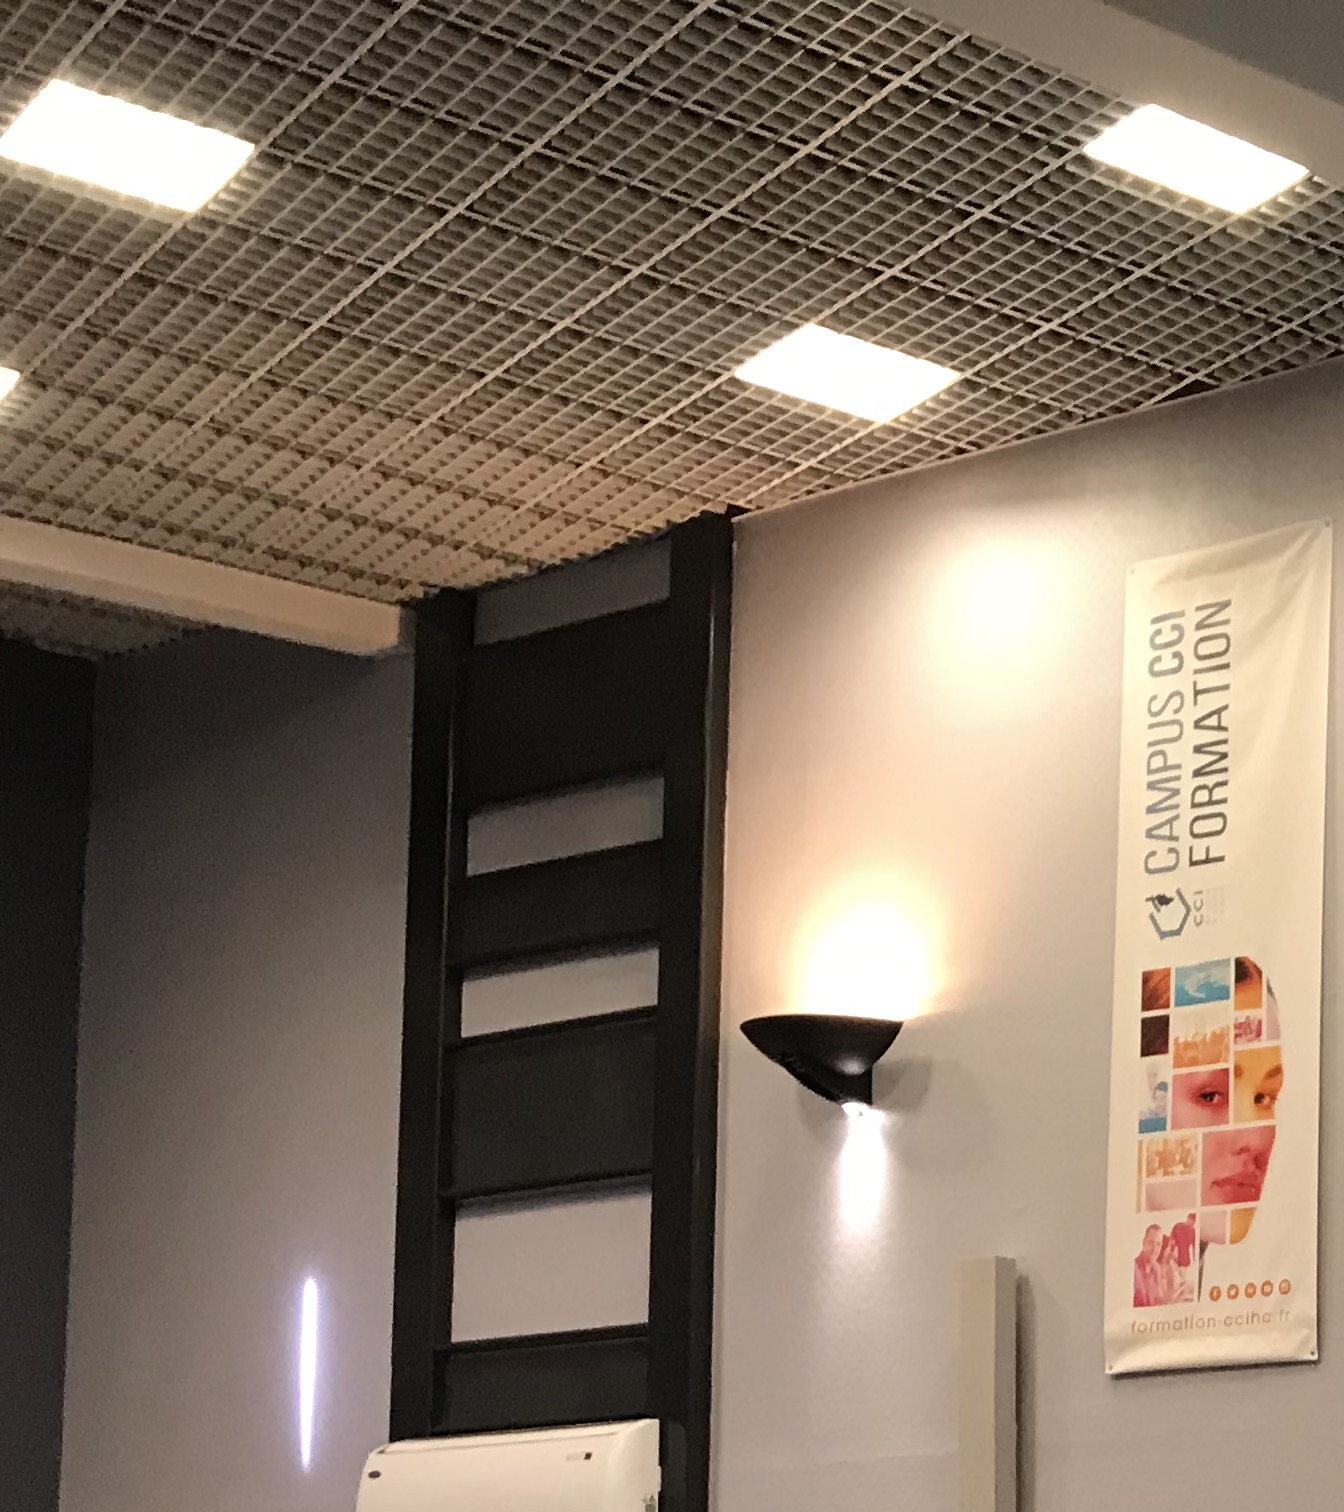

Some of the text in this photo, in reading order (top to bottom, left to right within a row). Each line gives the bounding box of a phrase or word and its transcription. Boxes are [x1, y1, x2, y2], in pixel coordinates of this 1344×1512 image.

[1143, 608, 1186, 876] CAMPUS CCI
[1188, 598, 1232, 869] FORMATION
[1193, 889, 1204, 927] CCI
